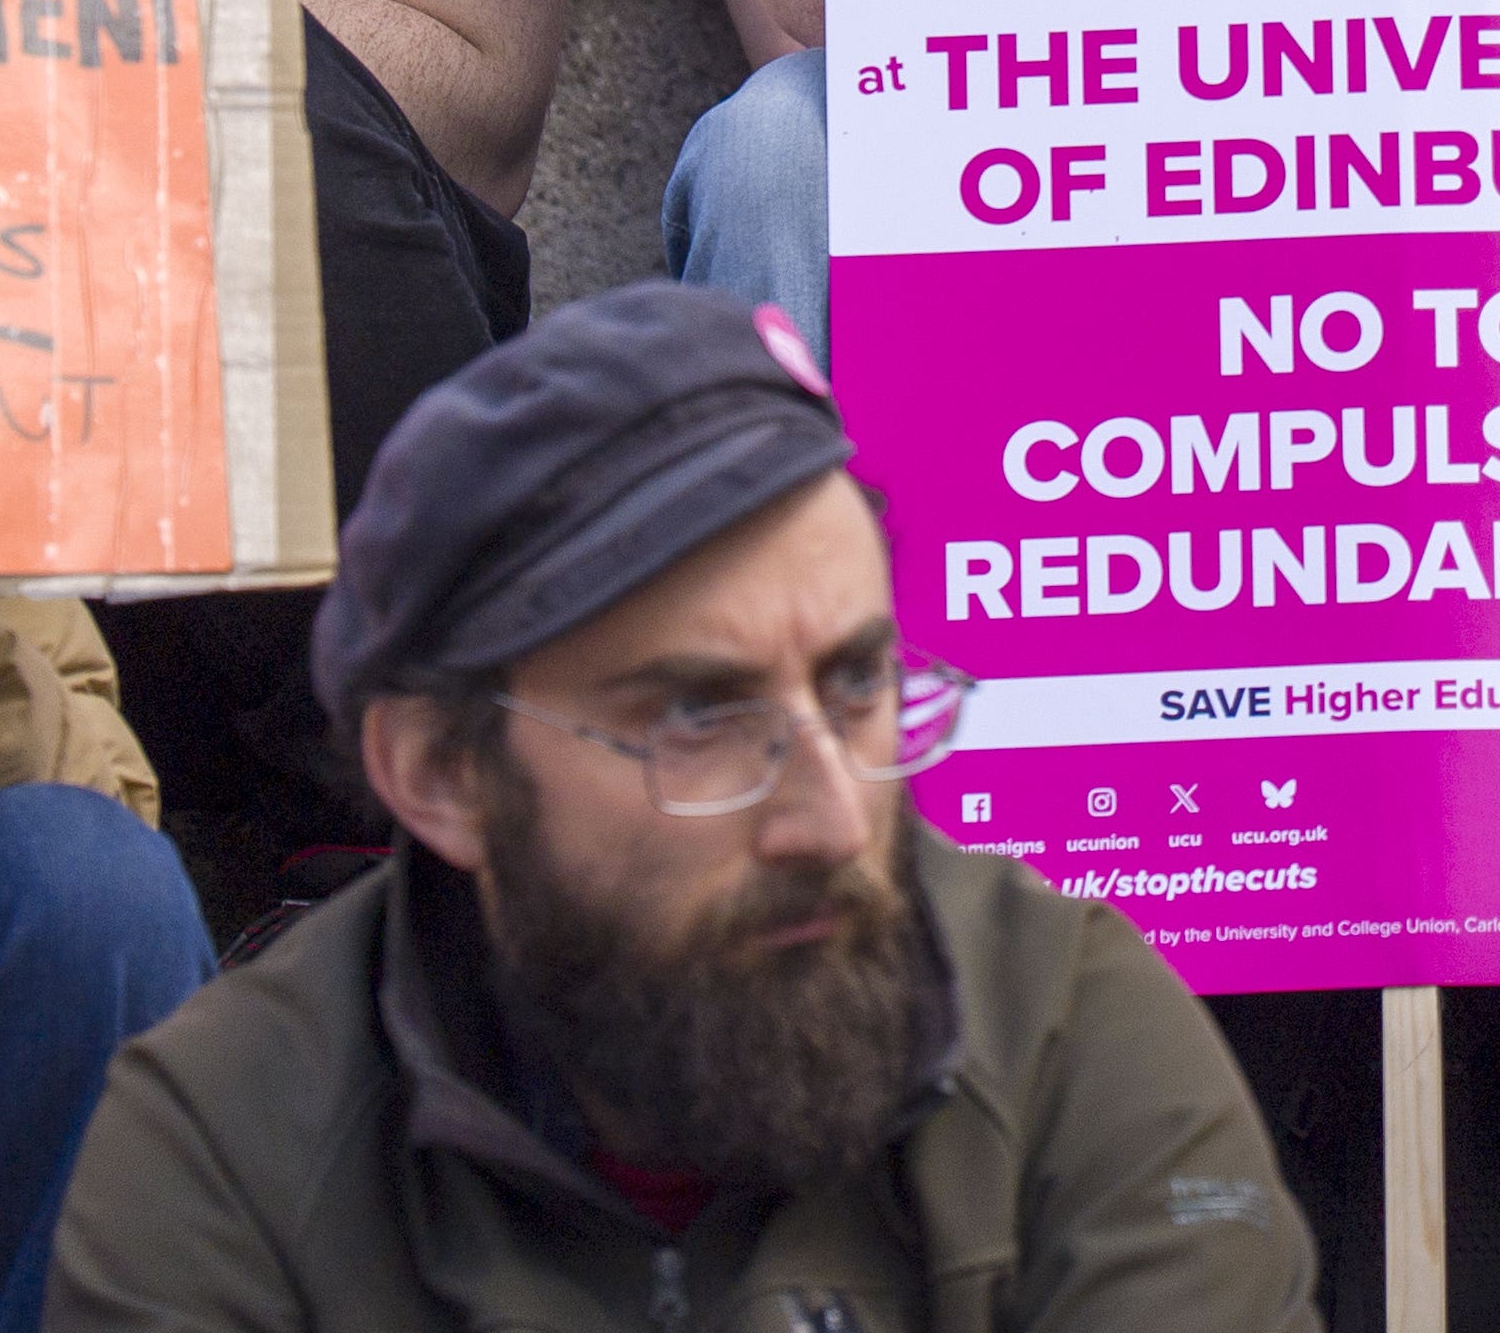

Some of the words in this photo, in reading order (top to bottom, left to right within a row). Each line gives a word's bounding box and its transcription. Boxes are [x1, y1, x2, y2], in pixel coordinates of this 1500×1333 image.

[856, 54, 907, 96] at
[926, 27, 1138, 110] THE
[958, 144, 1107, 225] OF
[1219, 291, 1384, 376] NO
[1159, 686, 1271, 723] SAVE
[1284, 680, 1420, 727] Higher
[1066, 835, 1140, 853] ucunion
[1168, 832, 1202, 849] ucu
[1231, 825, 1328, 847] ucu.org.uk
[1061, 862, 1317, 900] uk/stopthecuts
[1160, 929, 1181, 946] by
[1184, 928, 1212, 943] the
[1216, 923, 1297, 942] University
[1302, 921, 1333, 938] and
[1338, 919, 1401, 938] College
[1406, 917, 1460, 935] Union,
